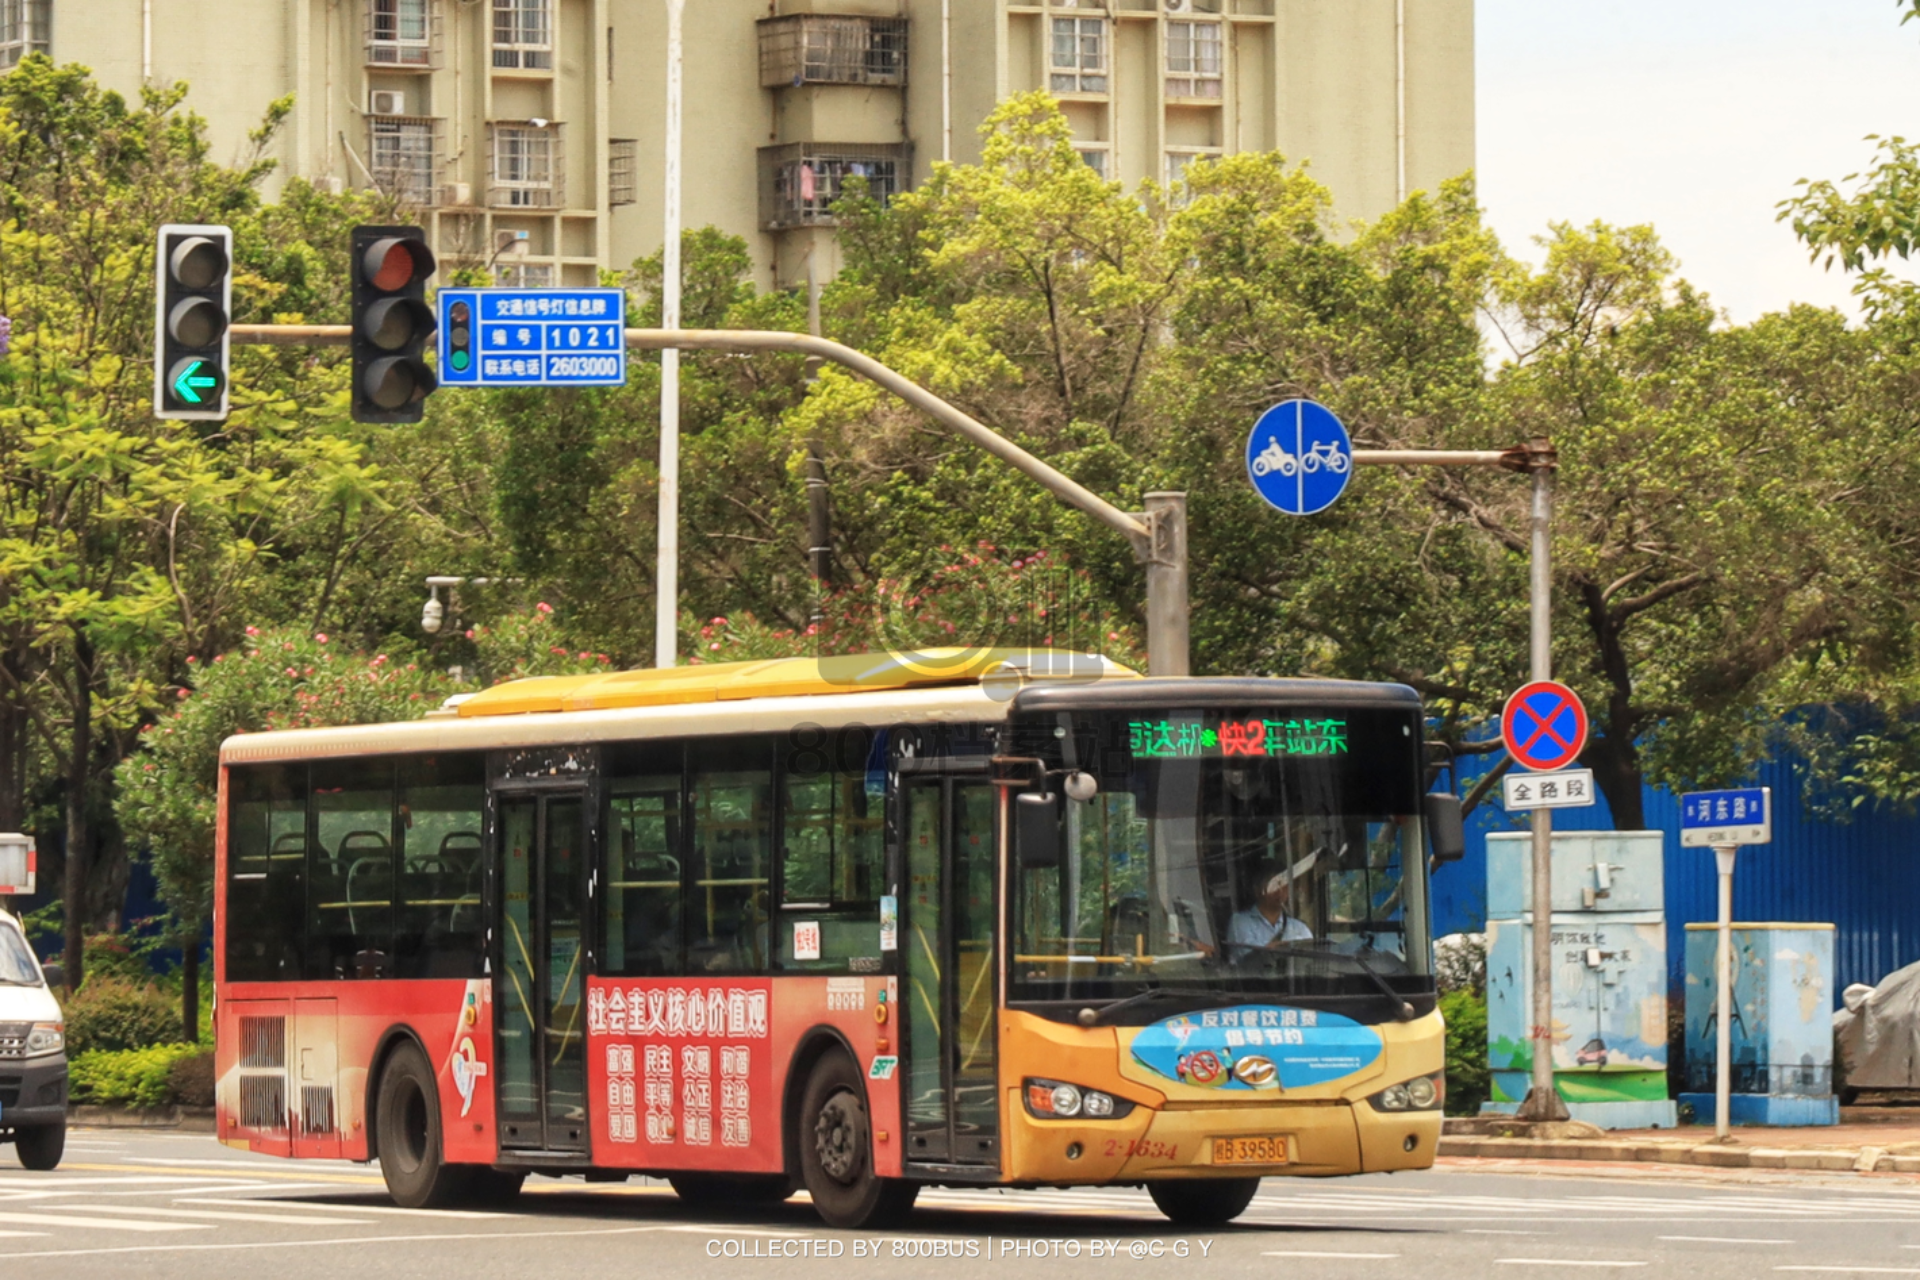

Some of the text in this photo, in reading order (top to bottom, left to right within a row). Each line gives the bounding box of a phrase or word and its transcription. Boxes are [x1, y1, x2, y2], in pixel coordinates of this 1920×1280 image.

[497, 299, 606, 316] 交通信号灯信息牌
[492, 327, 615, 347] 编号 1021
[485, 357, 617, 376] 联系电话 2603000
[1514, 779, 1585, 802] 全路段
[588, 987, 768, 1037] 社会主义核心价值观
[1202, 1010, 1317, 1028] 反对餐饮浪费
[1225, 1029, 1303, 1046] 倡导节约
[606, 1044, 750, 1079] 富强 民主 文明 和谐
[607, 1077, 749, 1112] 自由 平等 公正 法治
[608, 1110, 750, 1146] 爱国 敬业 诚信 友善
